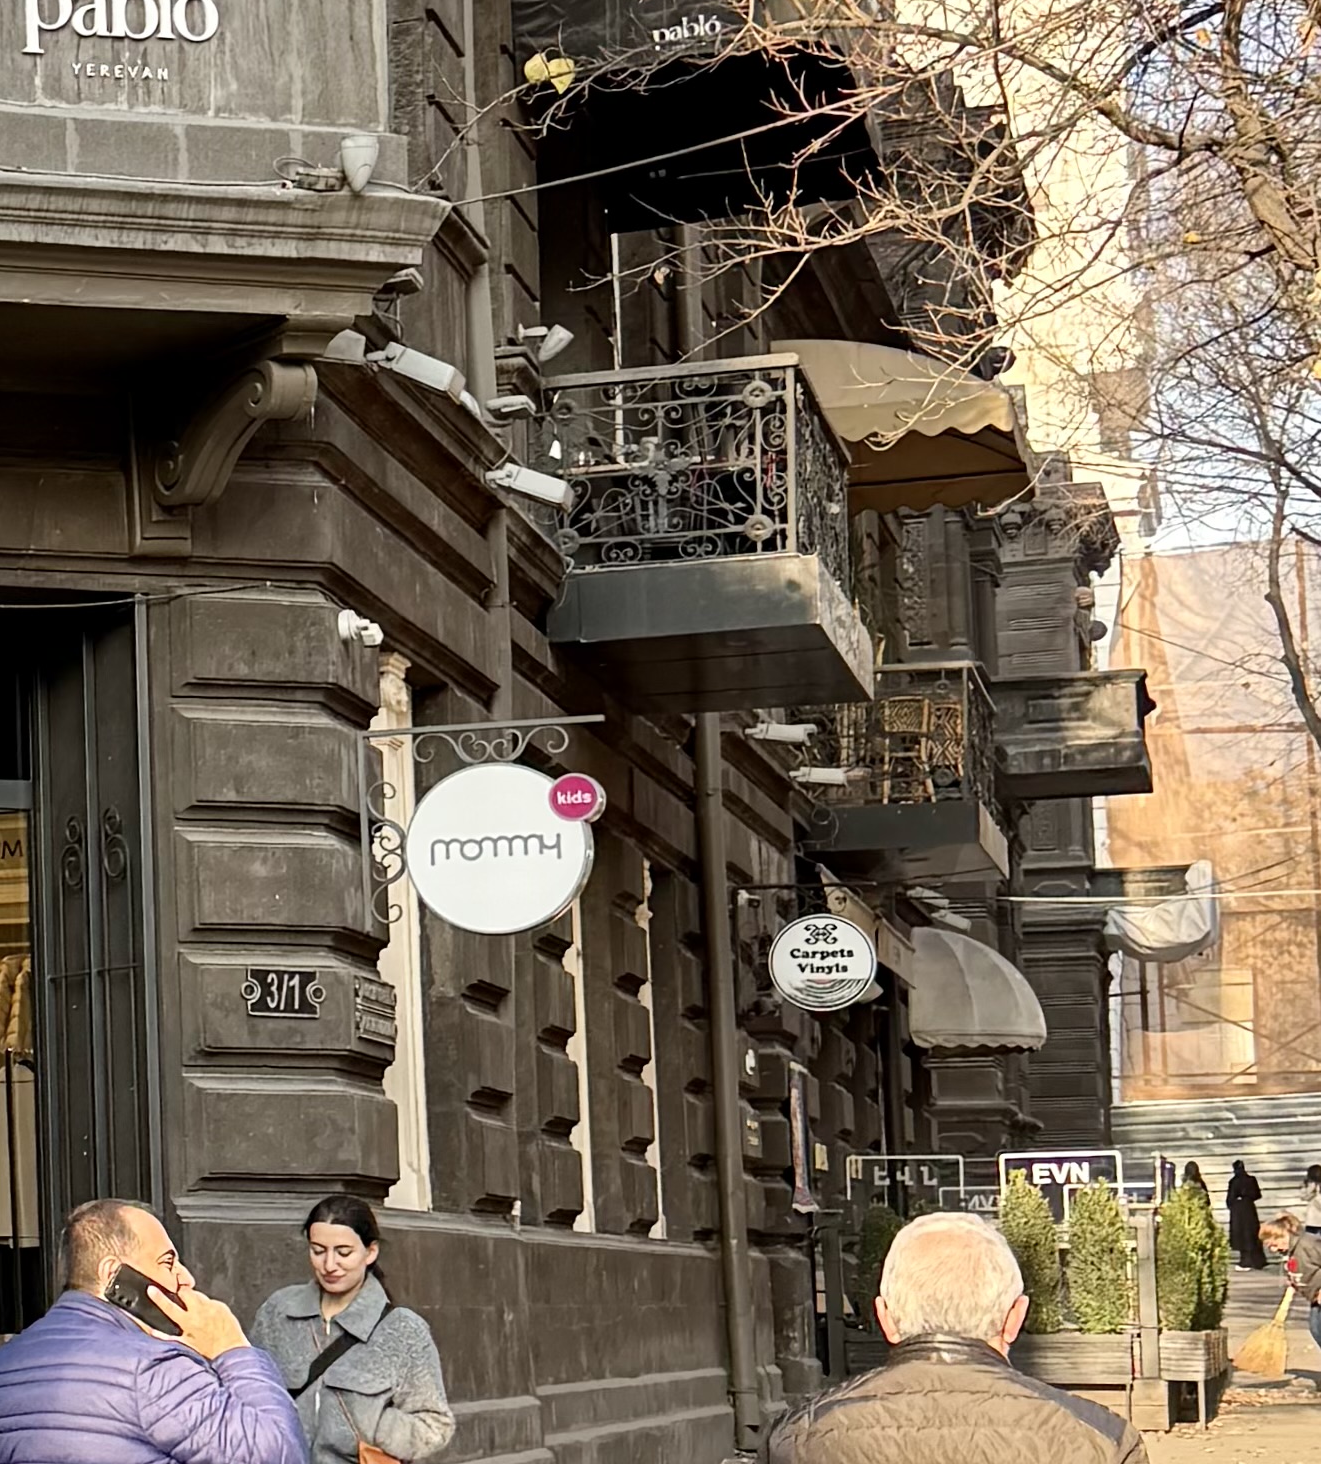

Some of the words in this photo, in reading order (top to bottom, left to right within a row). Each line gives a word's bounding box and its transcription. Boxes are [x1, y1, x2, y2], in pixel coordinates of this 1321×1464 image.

[71, 62, 169, 82] YEREVAN
[557, 790, 592, 805] kids
[431, 833, 561, 866] mommy
[790, 948, 854, 961] Carpets
[797, 963, 848, 975] Vinyls
[266, 972, 300, 1011] 3/1
[1032, 1162, 1090, 1185] EVN
